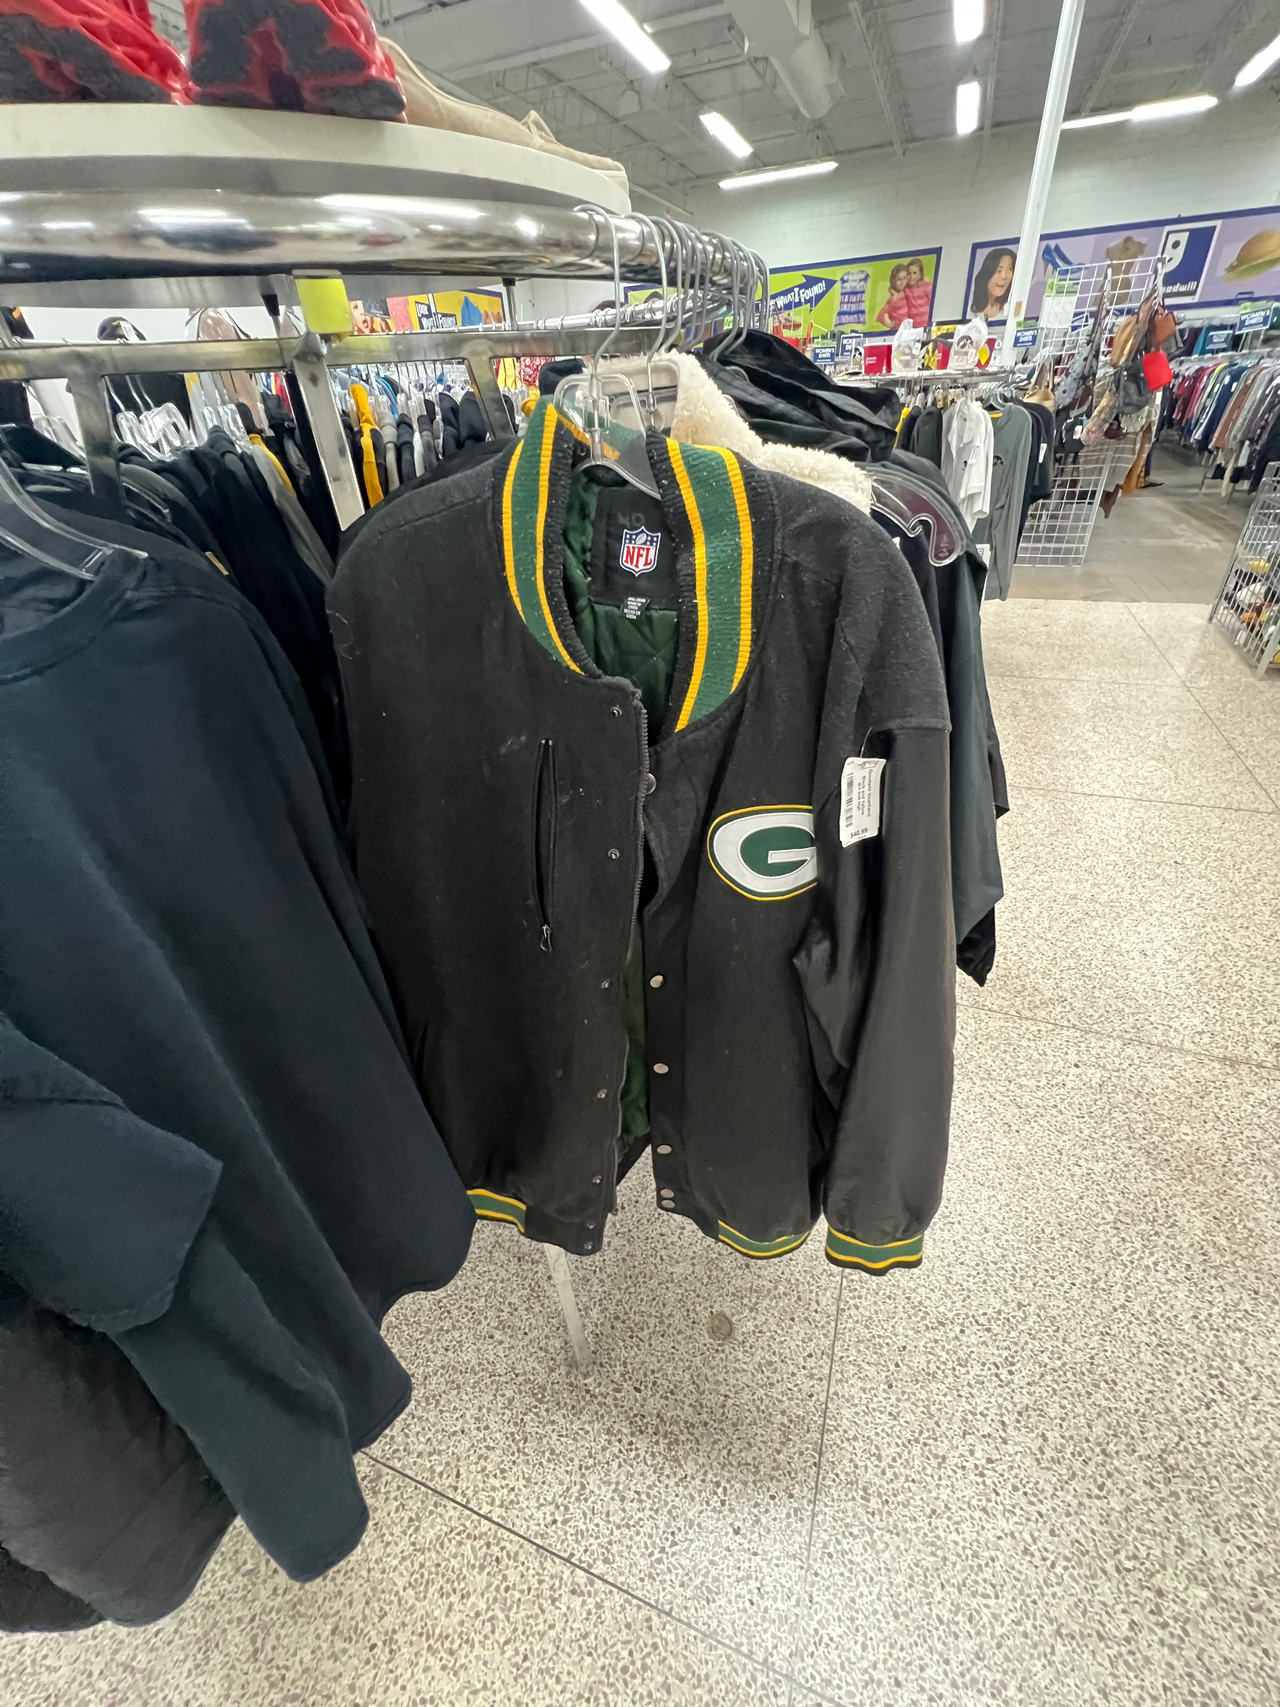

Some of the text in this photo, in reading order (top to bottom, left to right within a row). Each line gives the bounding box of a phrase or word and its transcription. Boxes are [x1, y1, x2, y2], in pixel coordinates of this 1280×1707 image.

[799, 280, 826, 303] FOUND!
[624, 545, 653, 569] NFL
[711, 810, 819, 895] G
